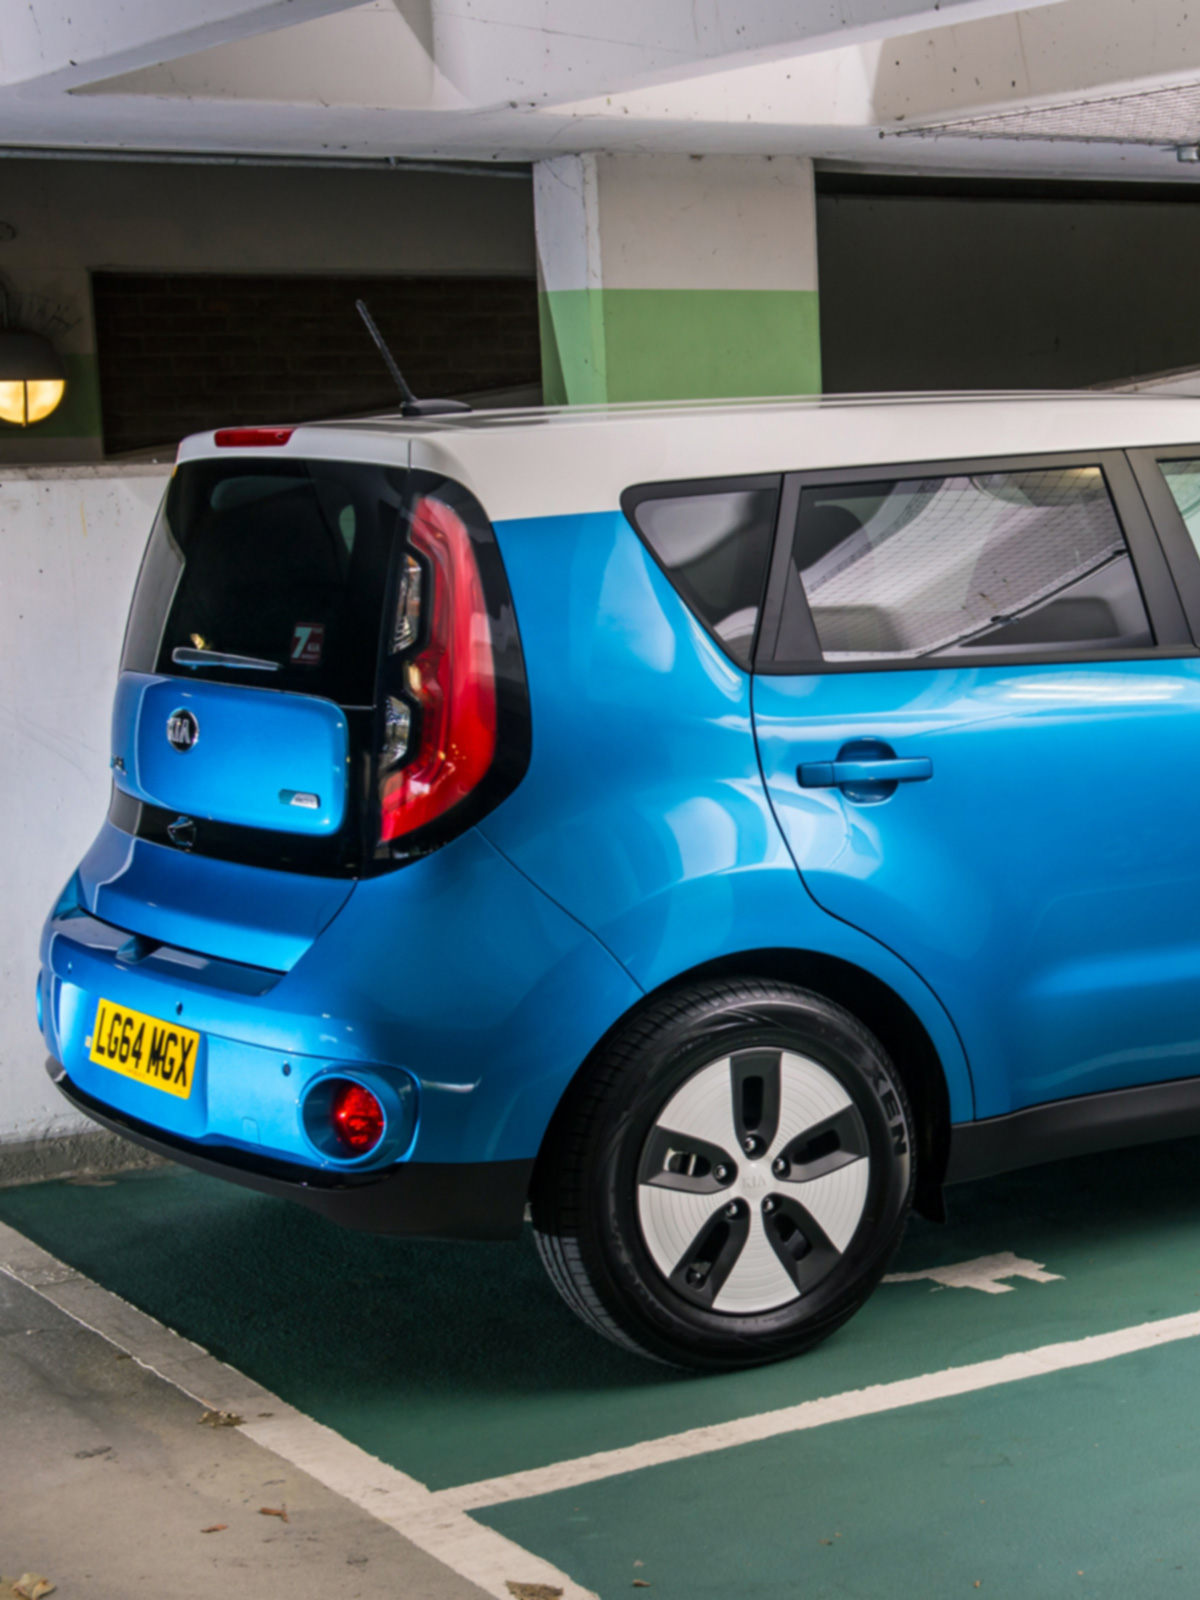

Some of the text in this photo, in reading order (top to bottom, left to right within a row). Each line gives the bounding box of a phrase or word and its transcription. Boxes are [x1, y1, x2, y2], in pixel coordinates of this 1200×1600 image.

[167, 717, 191, 744] KIA
[95, 1007, 194, 1087] LG64 MGX
